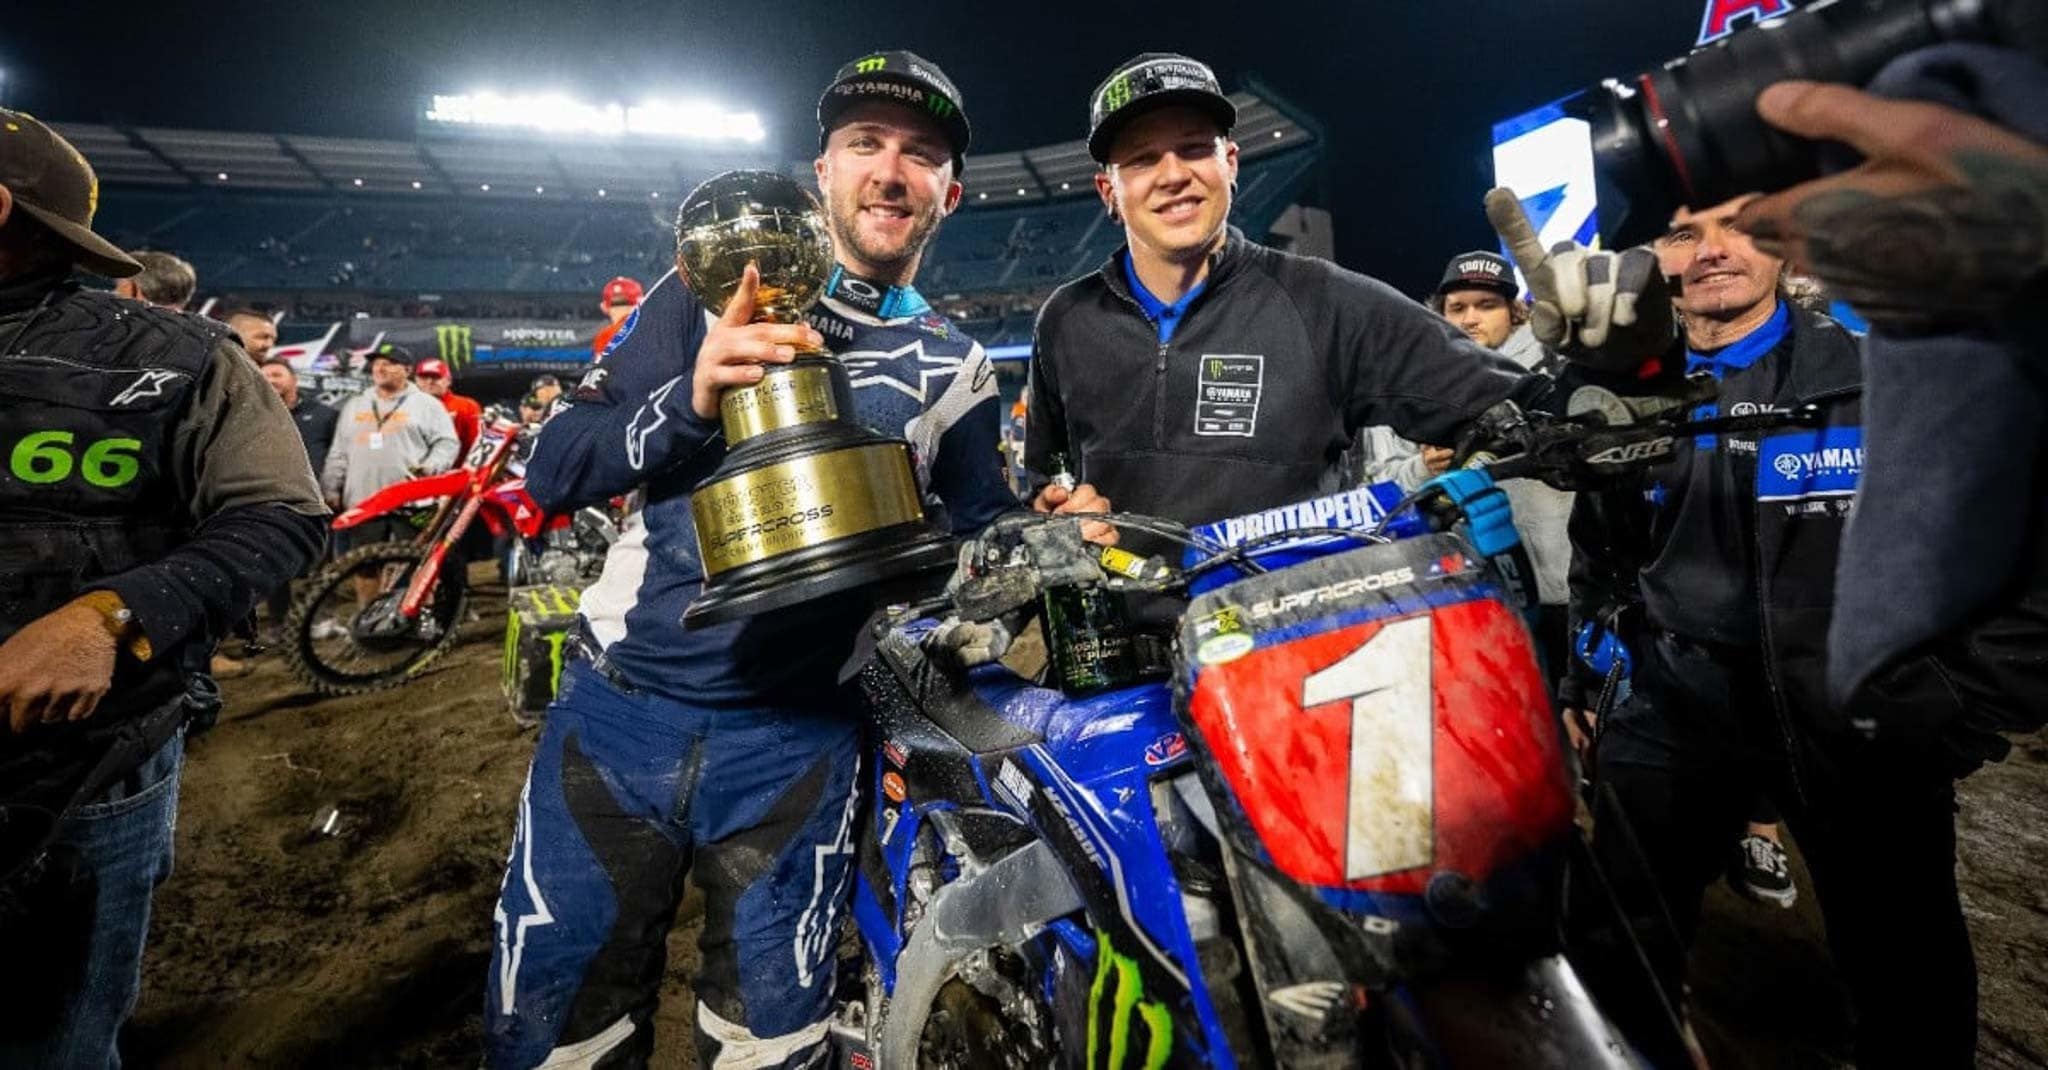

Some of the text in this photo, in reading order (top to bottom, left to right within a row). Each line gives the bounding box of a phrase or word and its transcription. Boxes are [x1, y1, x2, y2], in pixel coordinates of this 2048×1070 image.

[856, 82, 923, 102] YAMAHA
[1459, 260, 1503, 276] TROY LEE
[503, 328, 577, 341] MONSTER
[10, 430, 142, 488] 66
[1225, 486, 1375, 548] PROTAPER
[1251, 566, 1415, 620] SUPERCROSS
[1302, 613, 1434, 882] 1
